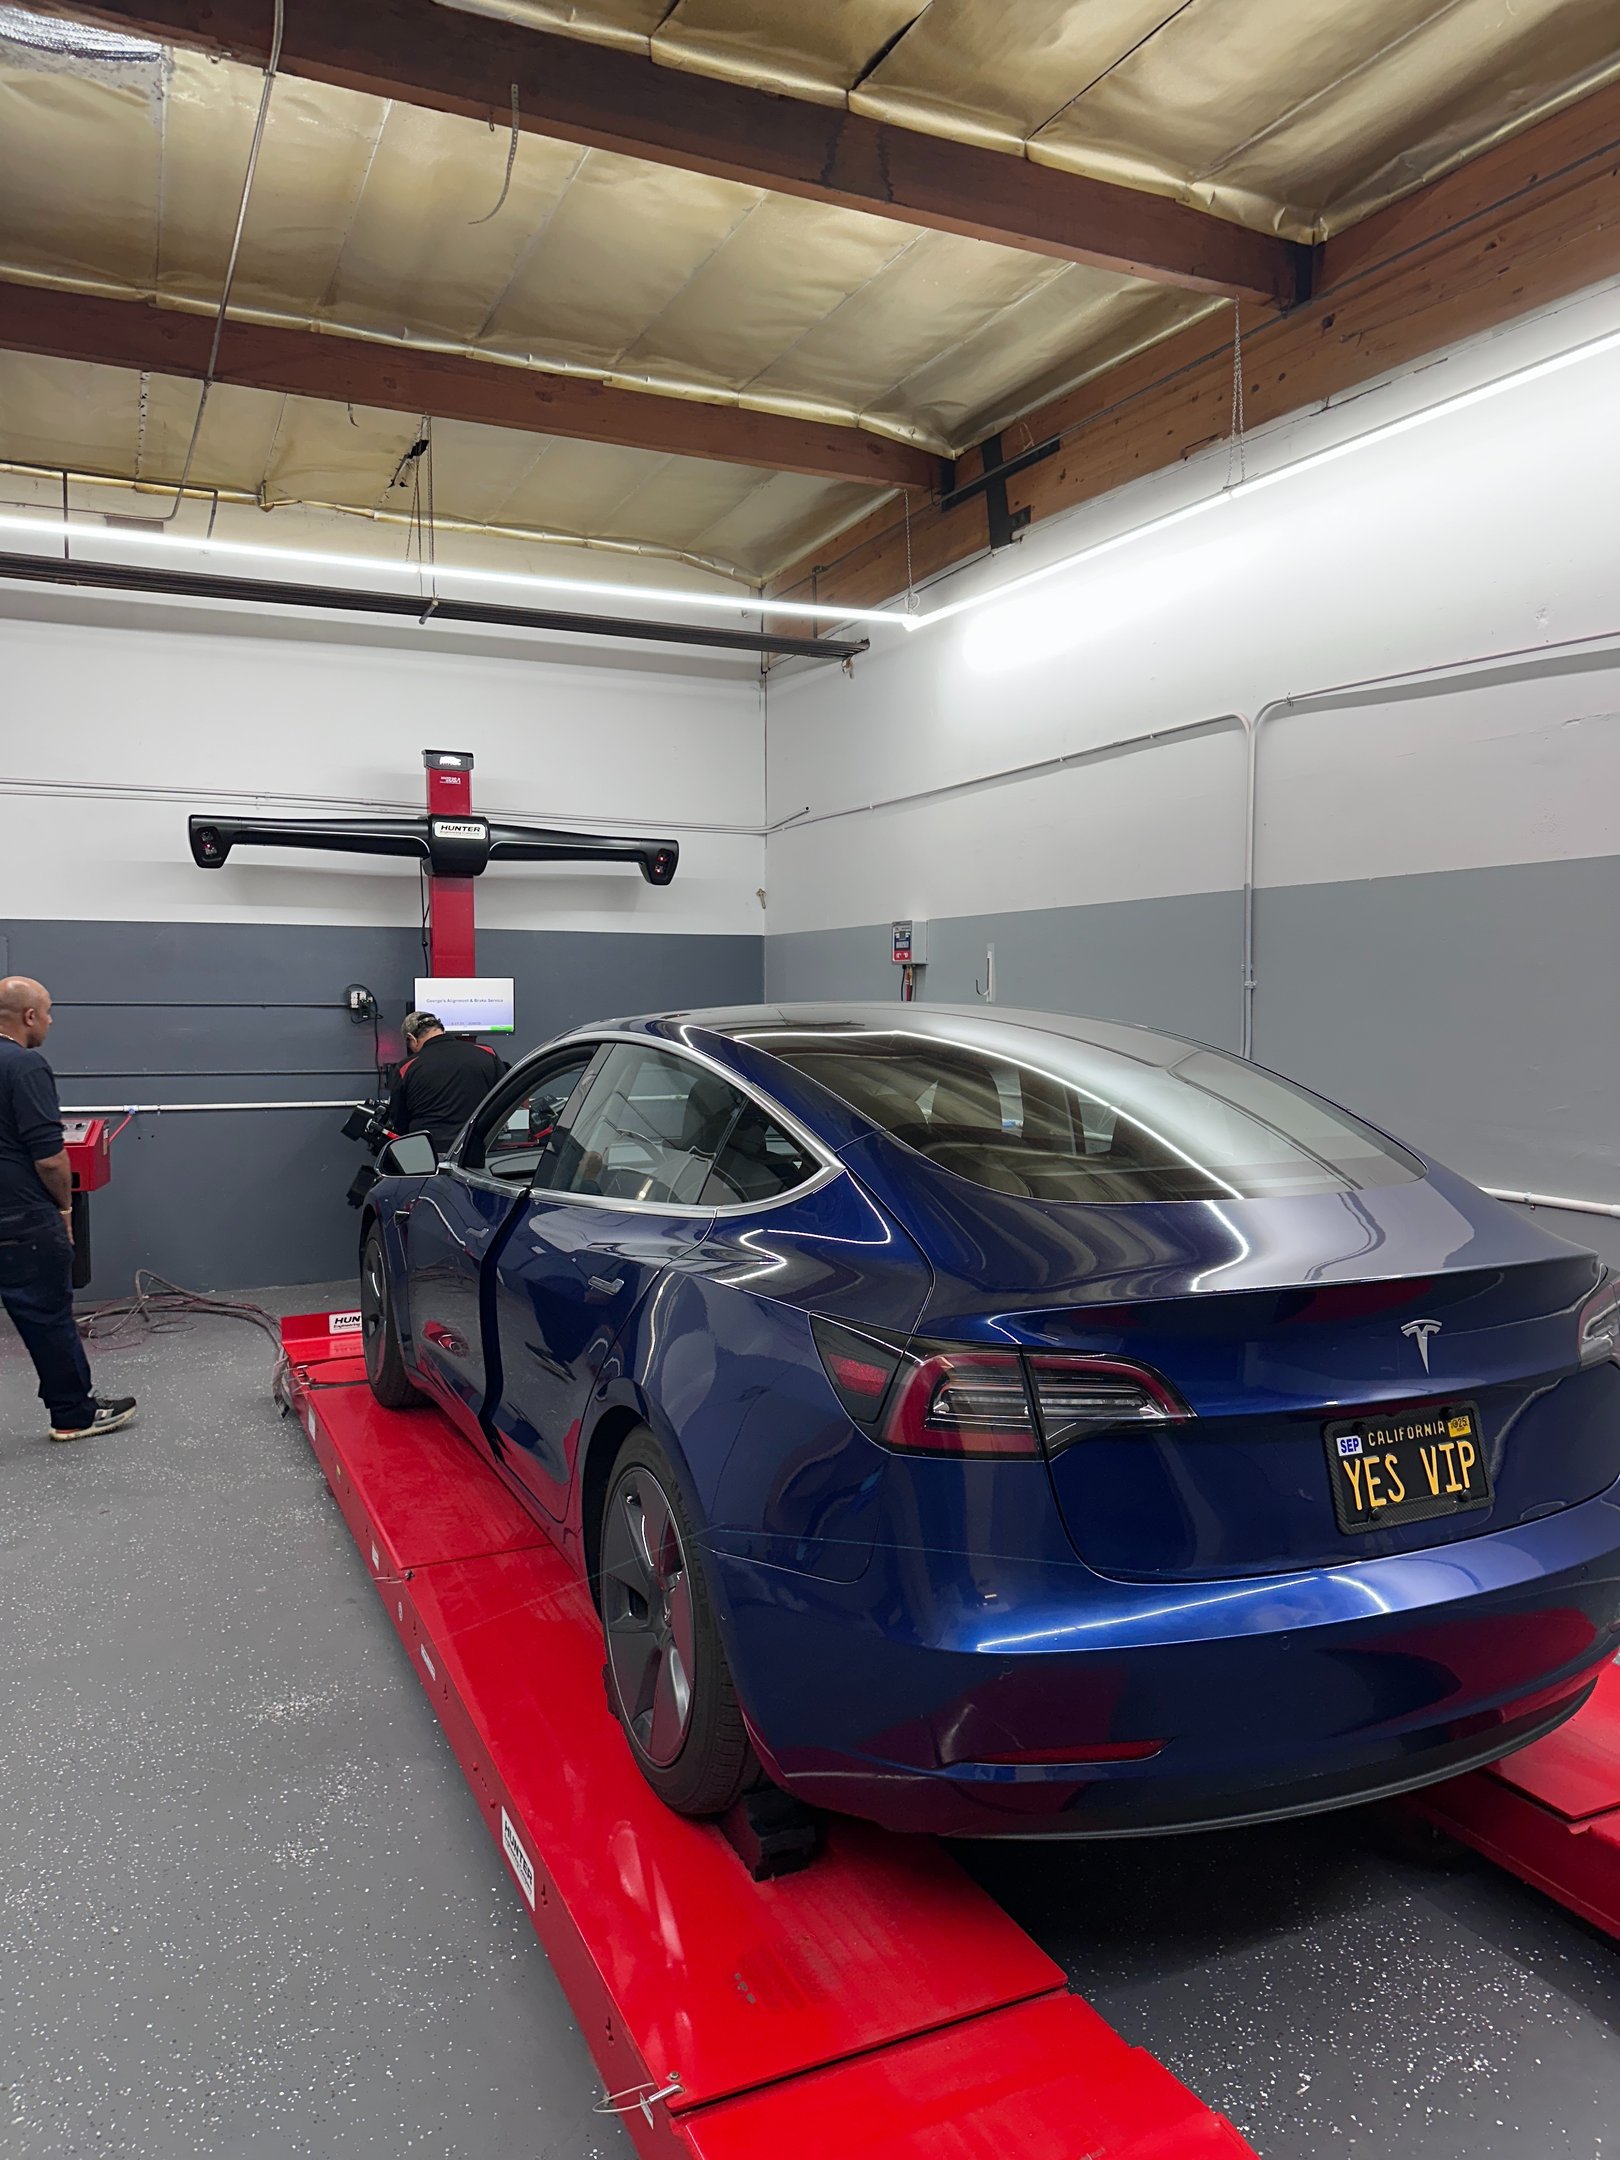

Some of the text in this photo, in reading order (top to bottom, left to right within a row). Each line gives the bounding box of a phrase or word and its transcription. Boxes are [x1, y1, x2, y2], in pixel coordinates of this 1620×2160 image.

[1340, 1436, 1360, 1454] SEP
[1367, 1420, 1446, 1447] CALIFORNIA
[1343, 1440, 1476, 1511] YES VIP
[504, 1820, 533, 1886] HUNTER
